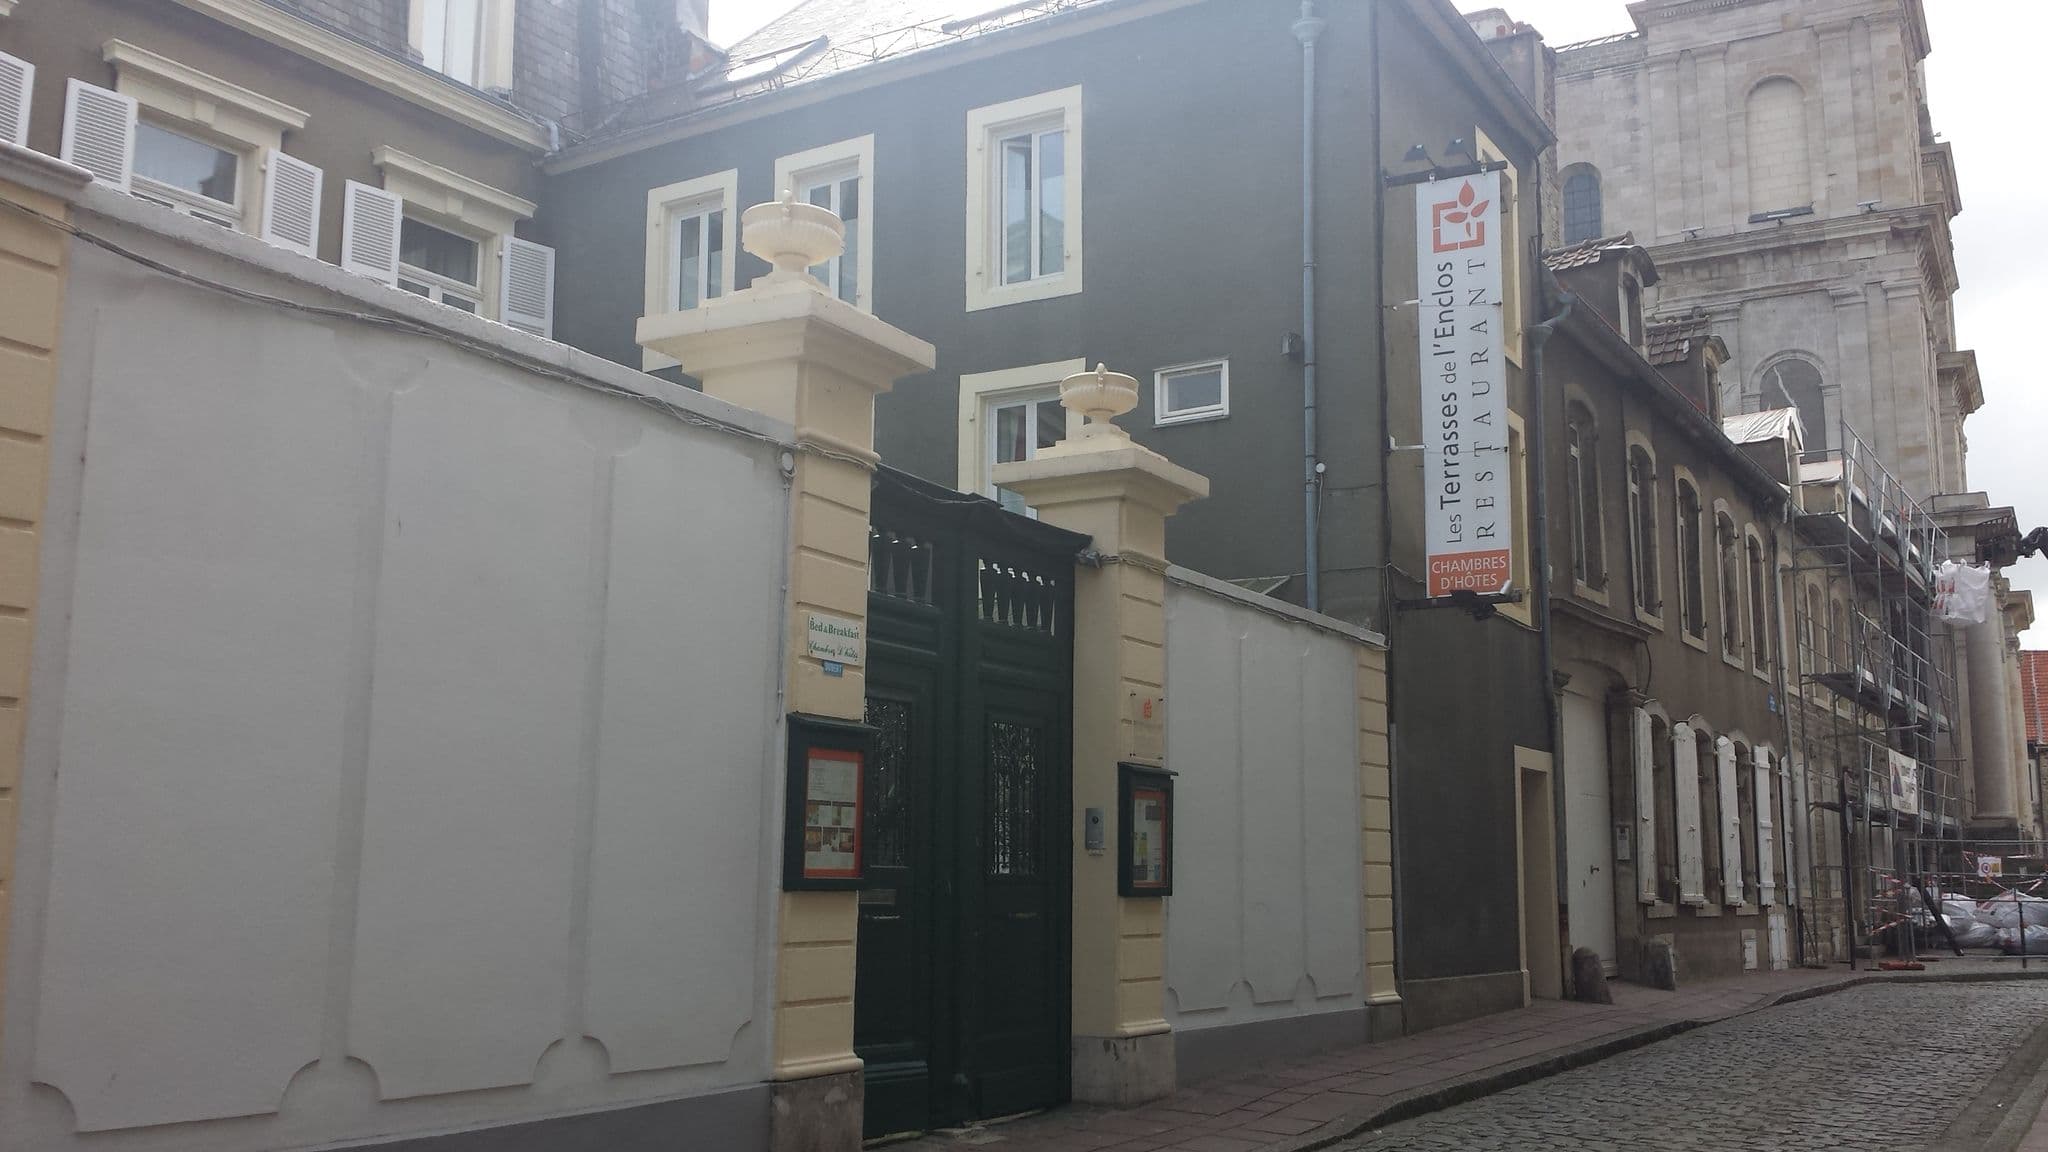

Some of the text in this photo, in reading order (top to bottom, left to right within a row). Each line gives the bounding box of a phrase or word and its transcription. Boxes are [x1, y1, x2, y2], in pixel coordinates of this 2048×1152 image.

[1432, 262, 1462, 543] Les Terrasses de l'Enclos
[1467, 259, 1495, 540] RESTAURANT
[1432, 556, 1506, 574] CHAMBRES
[1441, 572, 1497, 590] D'HÔTES
